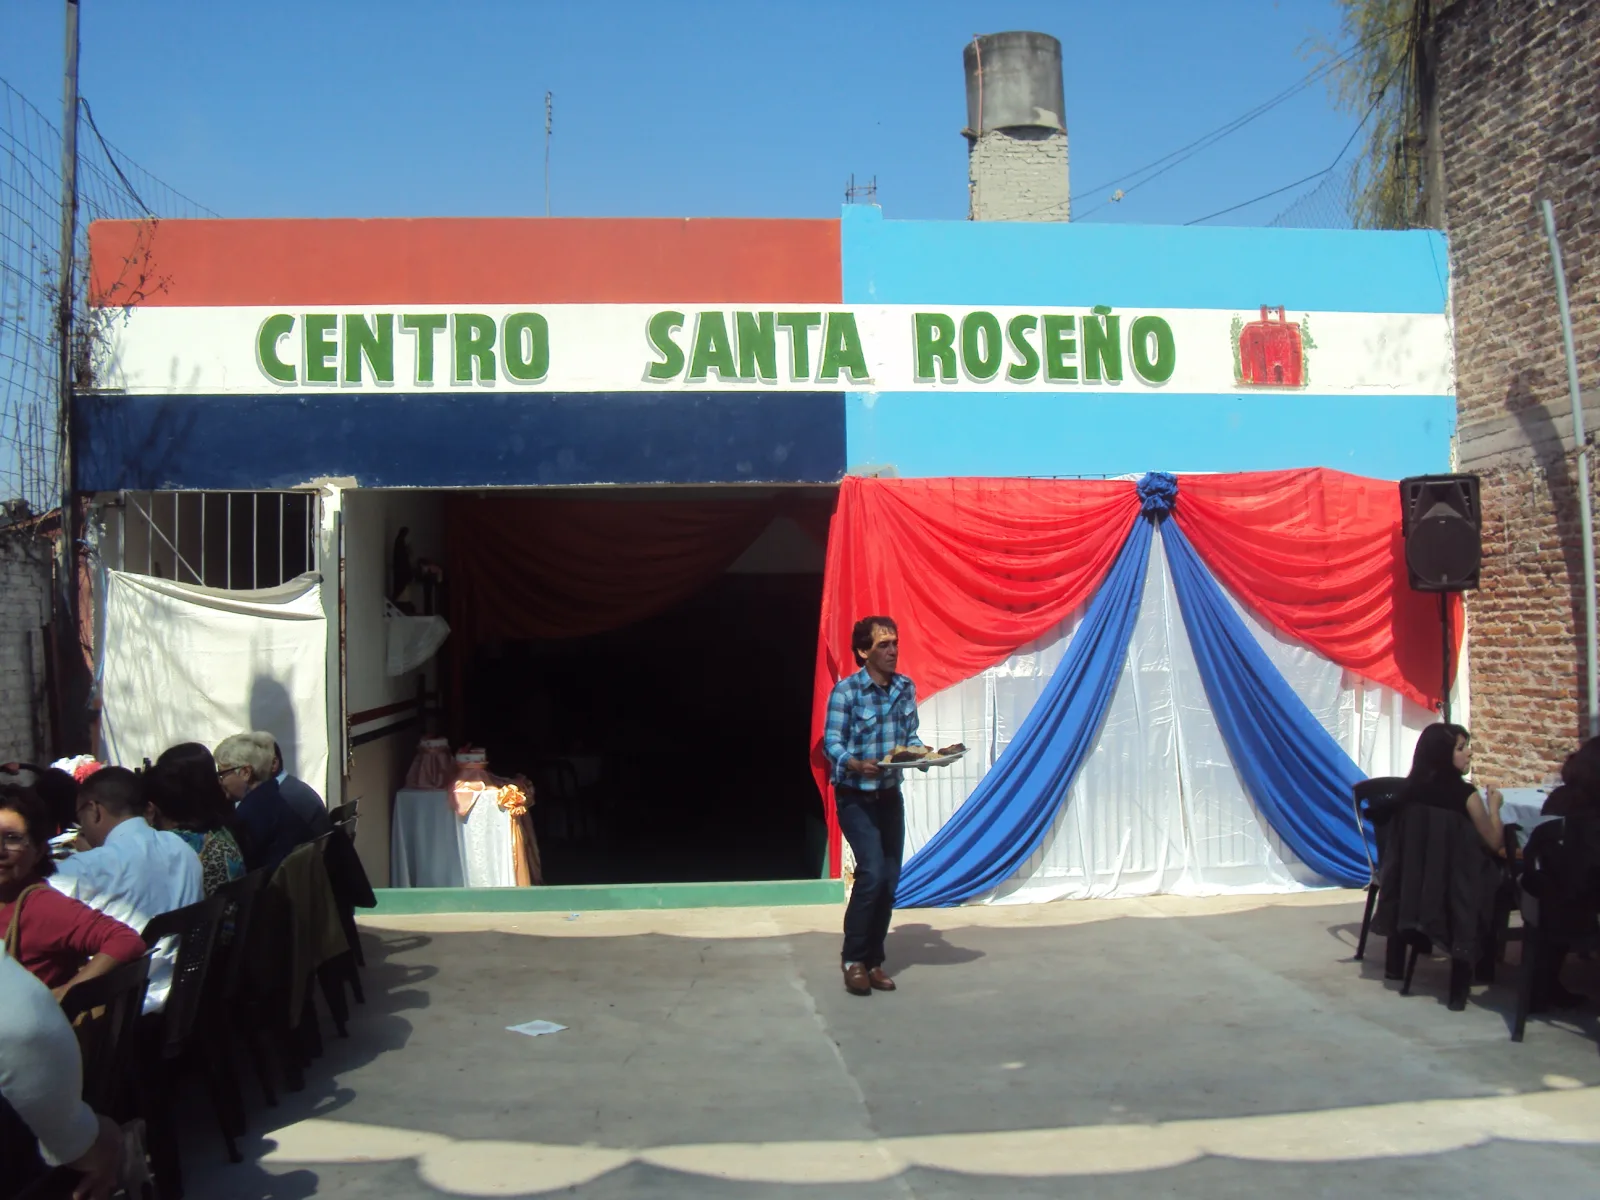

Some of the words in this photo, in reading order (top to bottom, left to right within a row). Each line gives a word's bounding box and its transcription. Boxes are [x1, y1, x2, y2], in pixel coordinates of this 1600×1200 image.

[256, 312, 550, 384] CENTRO
[645, 310, 871, 383] SANTA
[914, 304, 1176, 384] ROSEÑO
